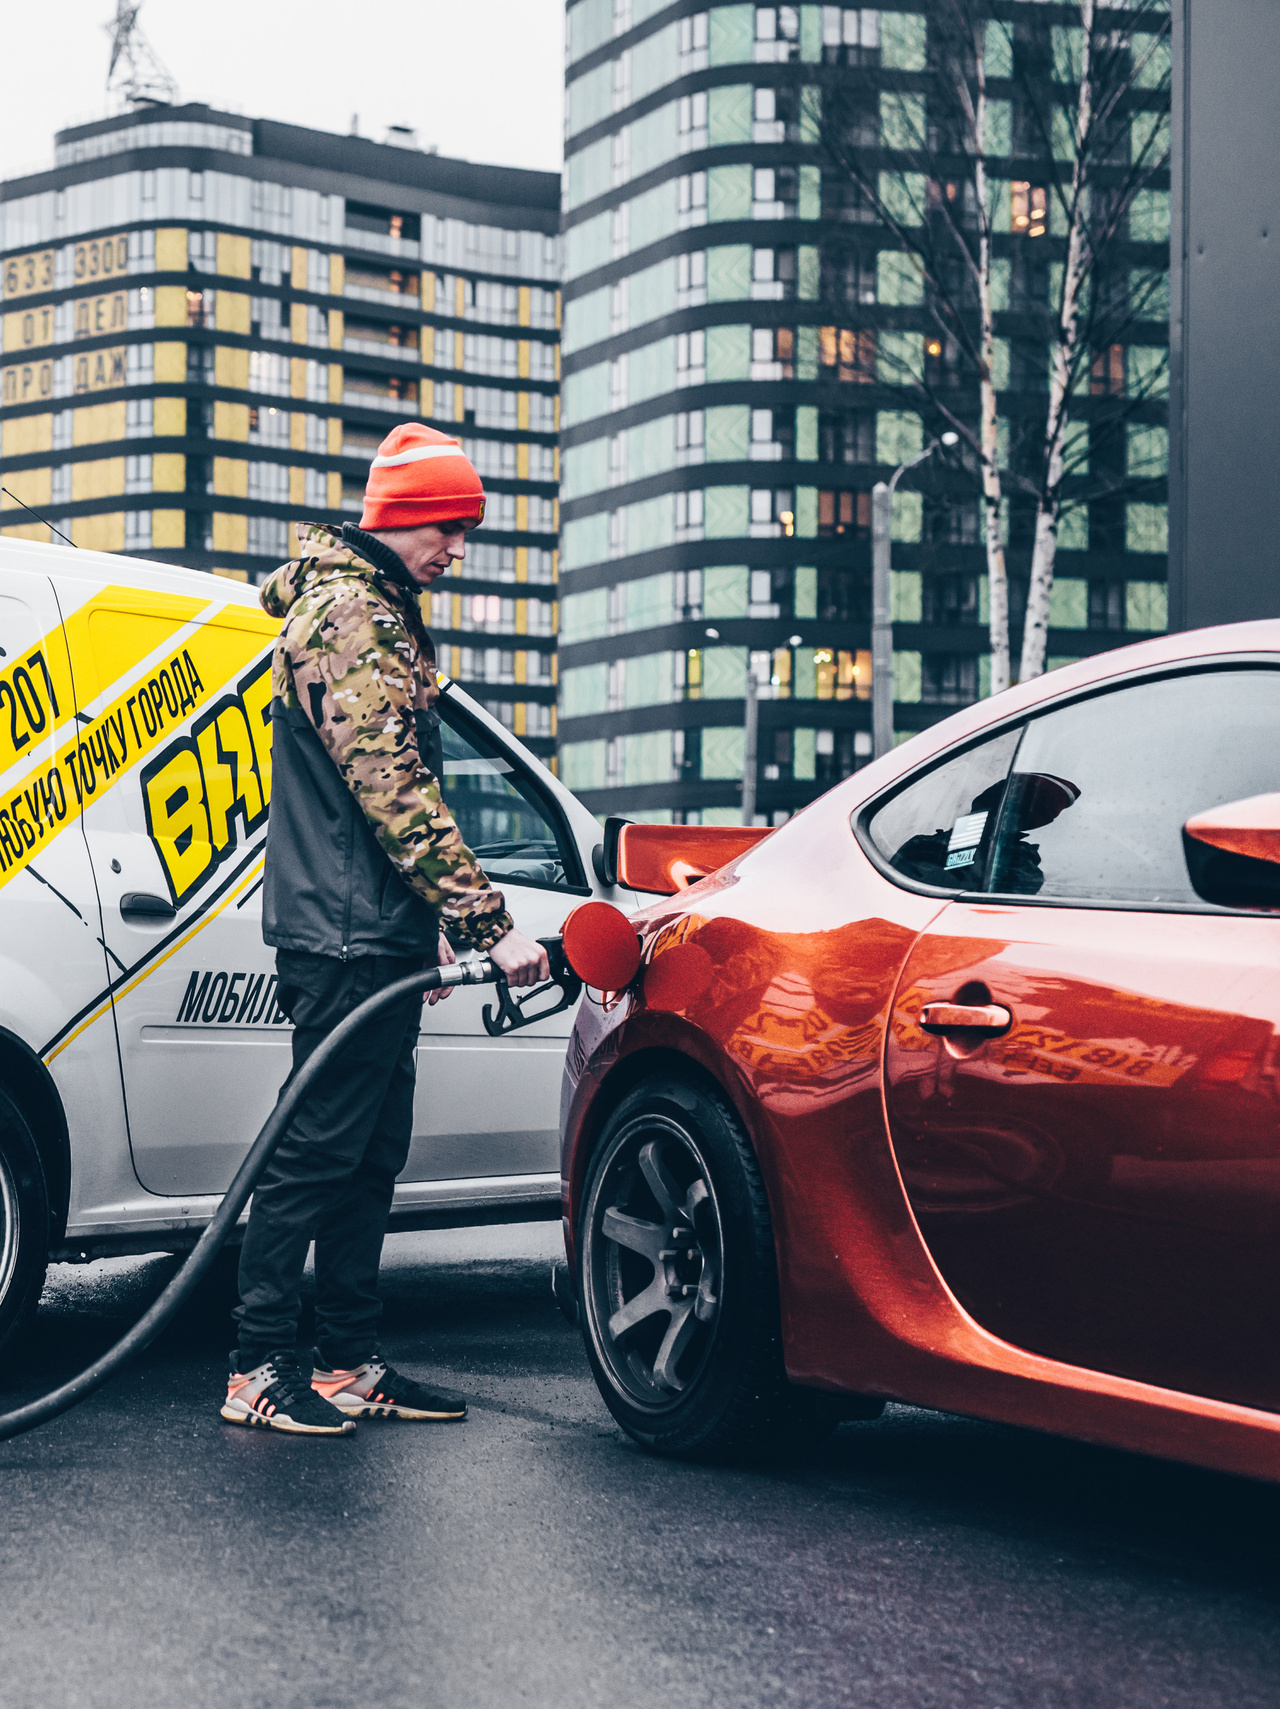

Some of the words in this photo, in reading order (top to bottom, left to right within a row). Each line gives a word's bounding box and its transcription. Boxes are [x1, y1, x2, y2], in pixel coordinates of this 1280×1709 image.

[7, 254, 52, 293] 633
[75, 237, 128, 278] 3300
[64, 708, 128, 806] ТОЧКУ
[126, 648, 205, 749] ГОРОДА
